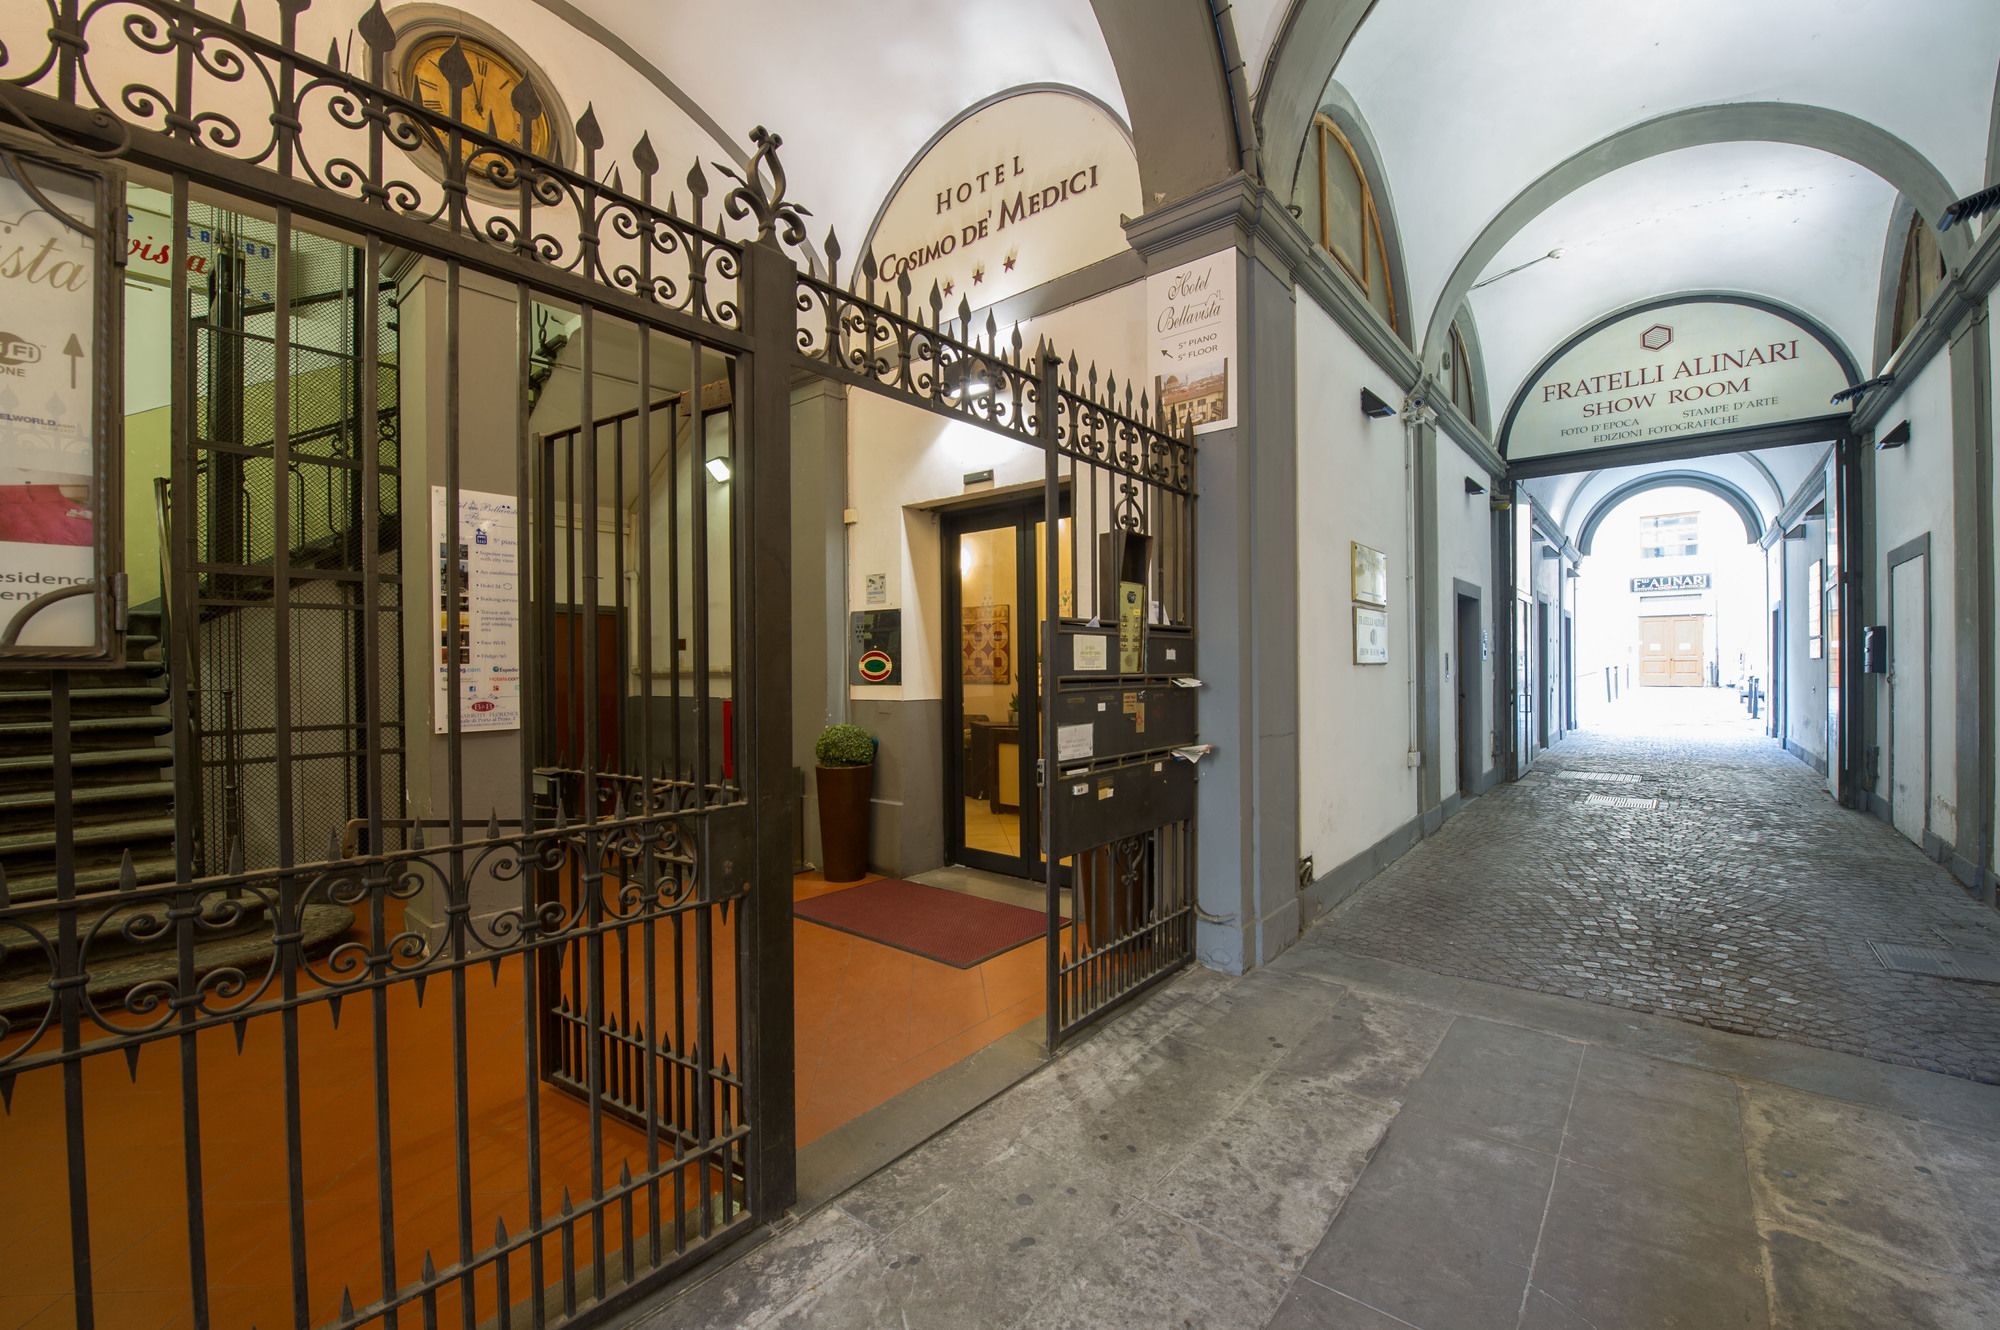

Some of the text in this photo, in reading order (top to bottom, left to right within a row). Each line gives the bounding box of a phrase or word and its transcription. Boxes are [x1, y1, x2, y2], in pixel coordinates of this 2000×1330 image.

[936, 155, 1025, 215] HOTEL
[961, 210, 992, 248] DE'
[997, 165, 1099, 231] MEDICI
[1168, 267, 1212, 301] Hotel
[1157, 300, 1221, 333] Bellavista
[1188, 333, 1218, 346] PIANO
[1188, 345, 1218, 358] FLOOR
[0, 366, 26, 378] ONE
[1542, 339, 1799, 403] FRATELLI ALINARI
[1583, 377, 1751, 418] SHOW ROOM
[1560, 426, 1589, 437] FOTO
[1682, 403, 1730, 418] STAMPE
[1733, 396, 1779, 411] D'ARTE
[1593, 414, 1739, 443] EDIZIONI FOTOGRAFICHE
